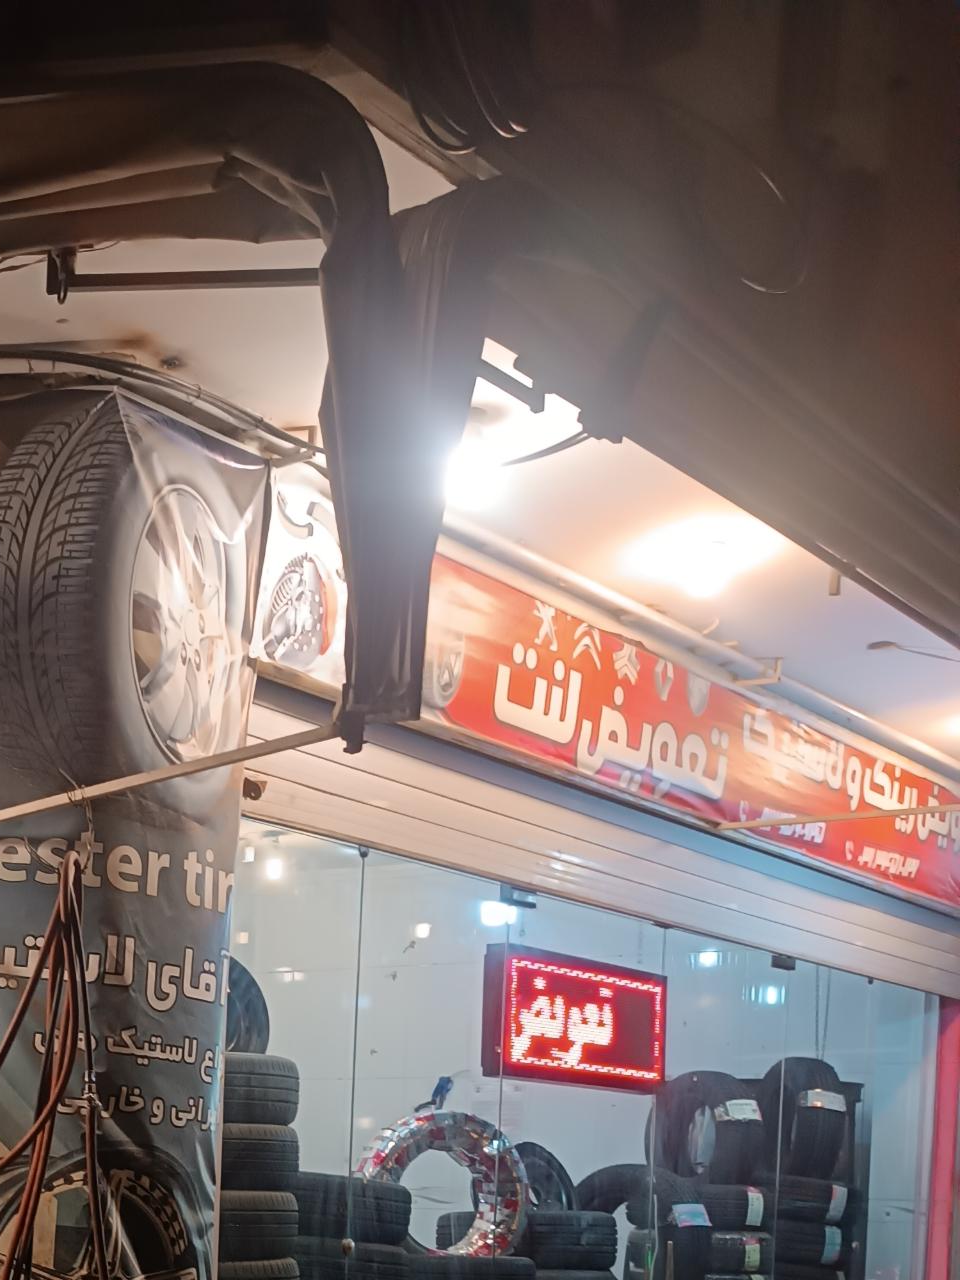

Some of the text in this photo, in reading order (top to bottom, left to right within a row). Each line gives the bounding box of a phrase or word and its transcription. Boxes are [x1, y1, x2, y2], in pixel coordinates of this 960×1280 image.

[493, 642, 730, 800] تعویض لنت
[845, 755, 862, 812] و
[183, 849, 234, 914] tir
[107, 1026, 198, 1065] لاستیک
[151, 1098, 165, 1125] و
